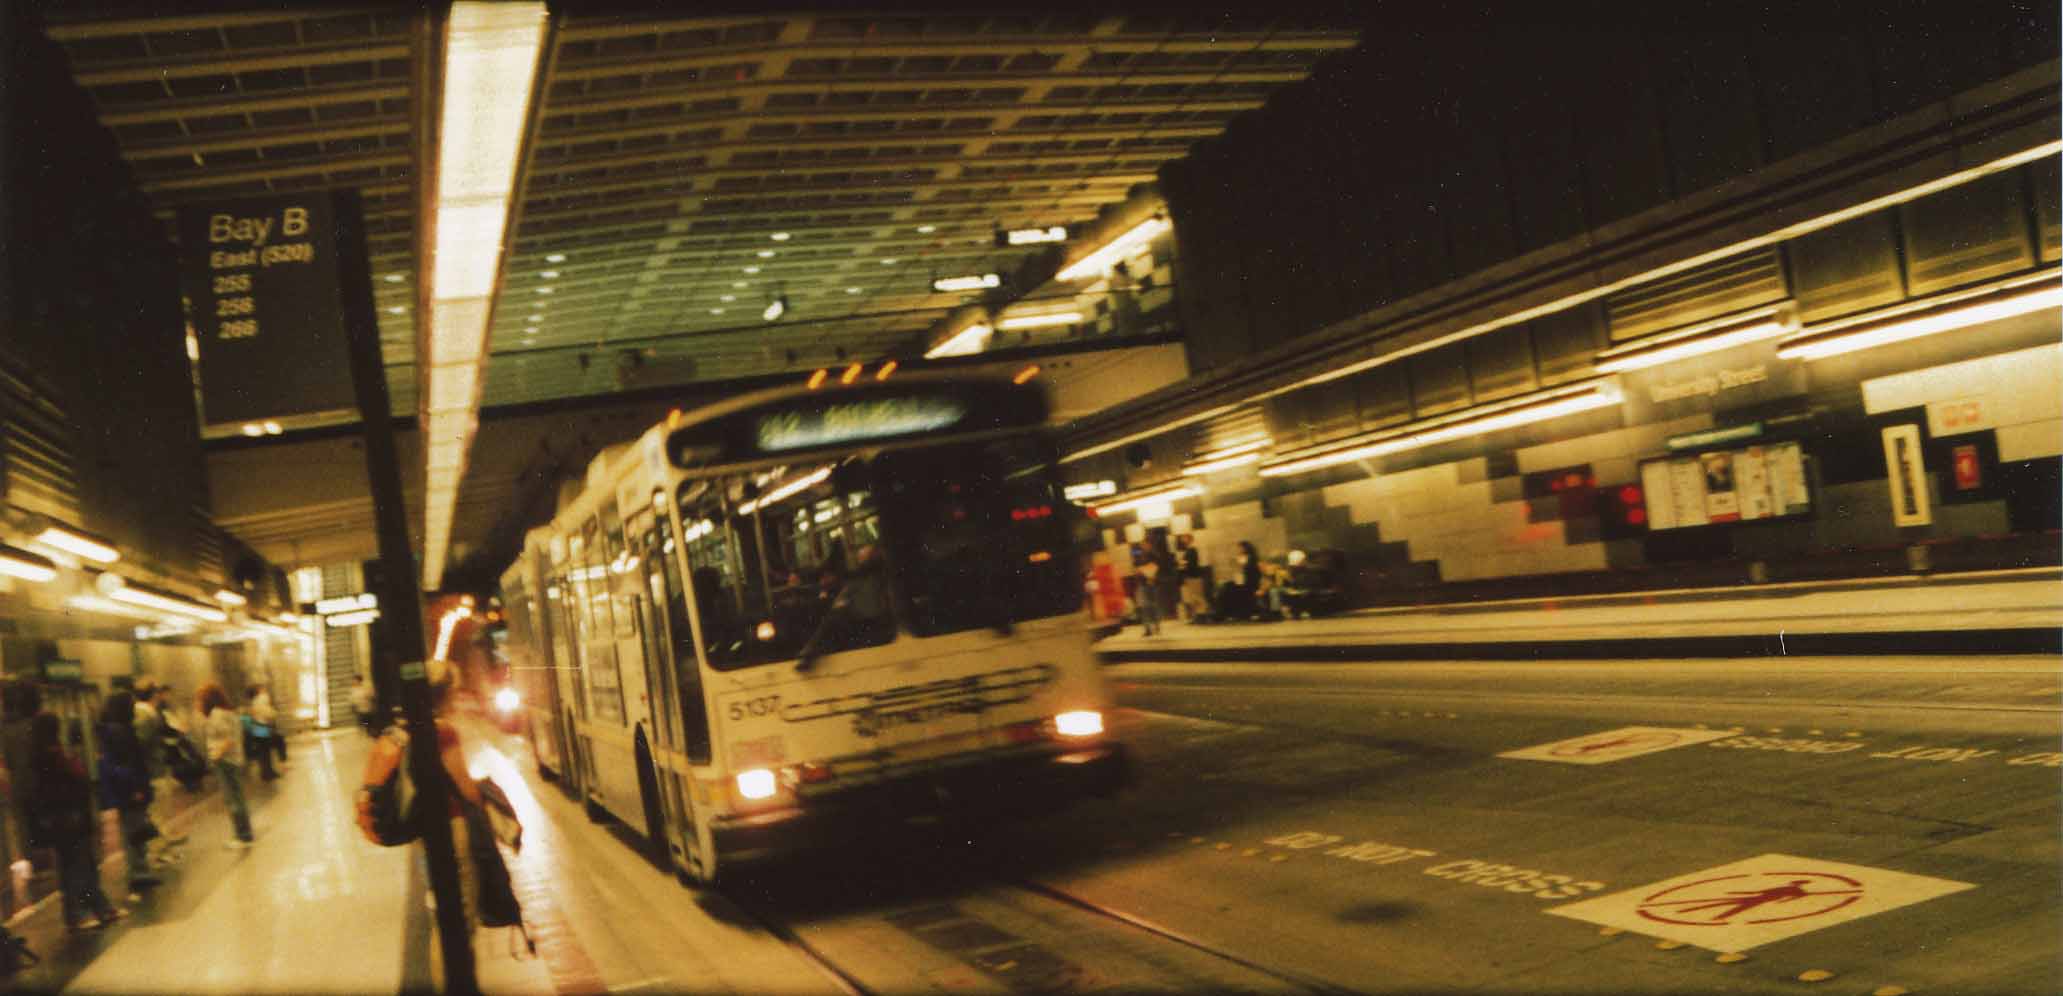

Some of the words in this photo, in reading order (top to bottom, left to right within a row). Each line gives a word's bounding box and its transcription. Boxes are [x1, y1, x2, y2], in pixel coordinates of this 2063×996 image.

[210, 214, 273, 245] Bay
[282, 207, 310, 237] B
[210, 250, 257, 269] East
[260, 242, 315, 268] (520)
[728, 695, 781, 722] 5137
[1323, 841, 1437, 865] NOT
[1422, 859, 1606, 899] CROSS
